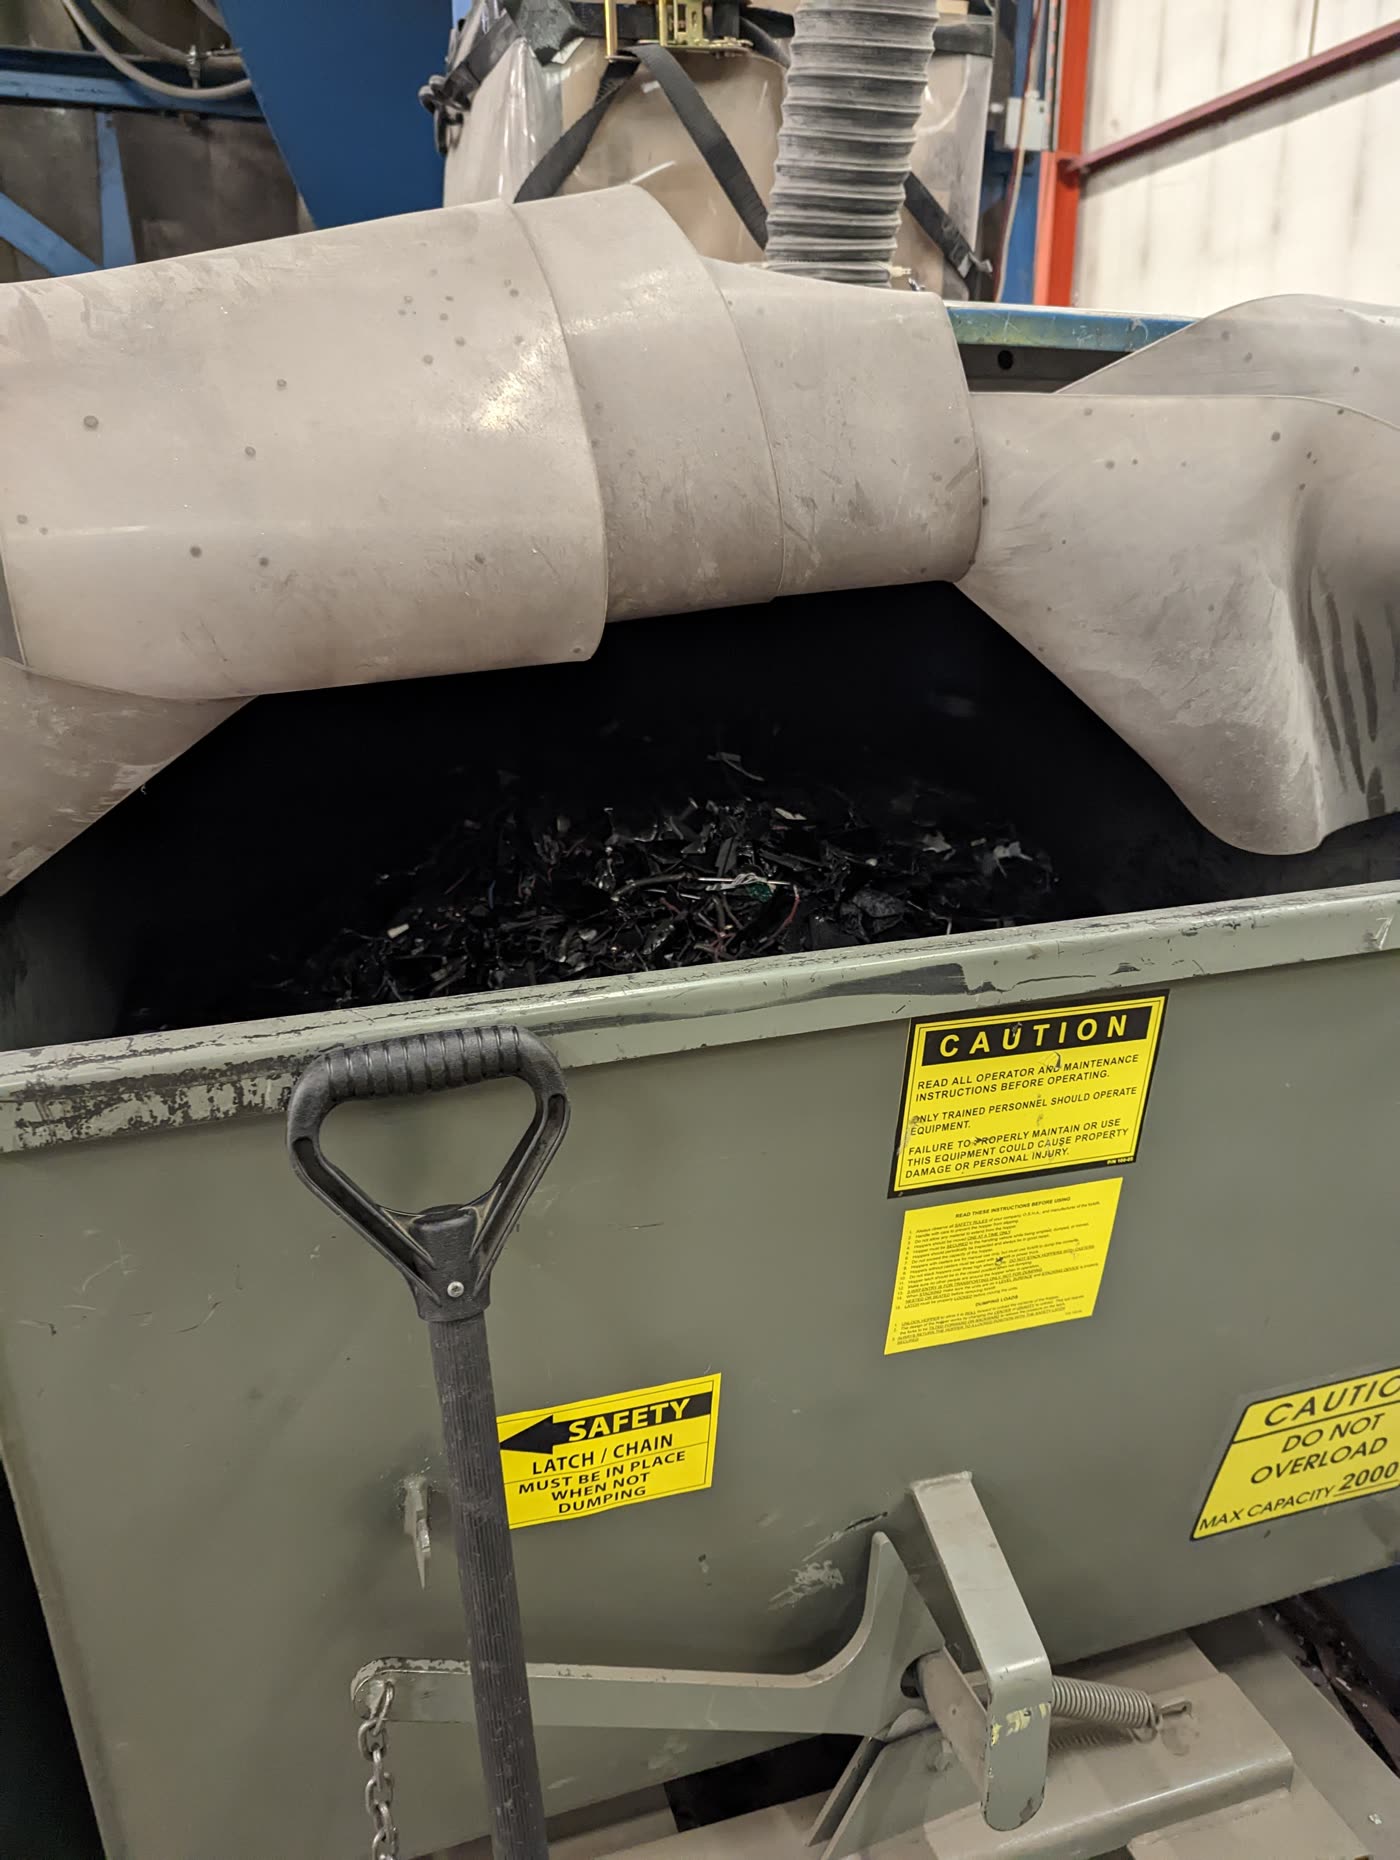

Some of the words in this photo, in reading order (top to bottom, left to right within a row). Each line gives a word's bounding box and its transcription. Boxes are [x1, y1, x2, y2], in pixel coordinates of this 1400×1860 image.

[940, 1015, 1127, 1057] CAUTION
[916, 1084, 996, 1101] INSTRUCTIONS
[1001, 1078, 1043, 1091] BEFORE
[1048, 1070, 1109, 1084] OPERATING.
[917, 1079, 948, 1090] READ
[951, 1075, 973, 1085] ALL
[976, 1068, 1034, 1082] OPERATOR
[1038, 1064, 1060, 1074] AND
[1064, 1054, 1138, 1071] MAINTENANCE
[913, 1112, 938, 1124] ONLY
[942, 1107, 985, 1120] TRAINED
[989, 1098, 1047, 1113] PERSONNEL
[1051, 1093, 1090, 1105] SHOULD
[1093, 1087, 1137, 1100] OPERATE
[909, 1142, 953, 1155] FAILURE
[957, 1139, 971, 1148] TO
[974, 1131, 1029, 1146] PROPERLY
[1032, 1125, 1079, 1138] MAINTAIN
[1083, 1122, 1097, 1131] OR
[1101, 1119, 1121, 1127] USE
[910, 1120, 970, 1135] EQUIPMENT.
[905, 1165, 951, 1178] DAMAGE
[955, 1163, 970, 1171] OR
[973, 1154, 1028, 1168] PERSONAL
[1032, 1149, 1069, 1161] INJURY.
[908, 1156, 931, 1167] THIS
[935, 1147, 995, 1163] EQUIPMENT
[999, 1142, 1034, 1154] COULD
[1037, 1136, 1071, 1147] CAUSE
[1075, 1128, 1128, 1143] PROPERTY
[991, 1203, 1030, 1213] INSTRUCTIONS
[1265, 1375, 1400, 1426] CAUTIO
[568, 1398, 690, 1442] SAFETY
[1281, 1429, 1323, 1453] DO
[1329, 1413, 1385, 1440] NOT
[519, 1477, 573, 1494] MUST
[579, 1471, 600, 1484] BE
[606, 1466, 624, 1478] IN
[630, 1451, 685, 1471] PLACE
[533, 1452, 594, 1475] LATCH
[601, 1448, 607, 1463] /
[613, 1434, 673, 1458] CHAIN
[1251, 1437, 1387, 1484] OVERLOAD
[552, 1483, 607, 1501] WHEN
[613, 1473, 649, 1489] NOT
[559, 1487, 646, 1513] DUMPING
[1199, 1508, 1244, 1530] MAX
[1247, 1485, 1335, 1517] CAPACITY
[1339, 1462, 1399, 1491] 2000
